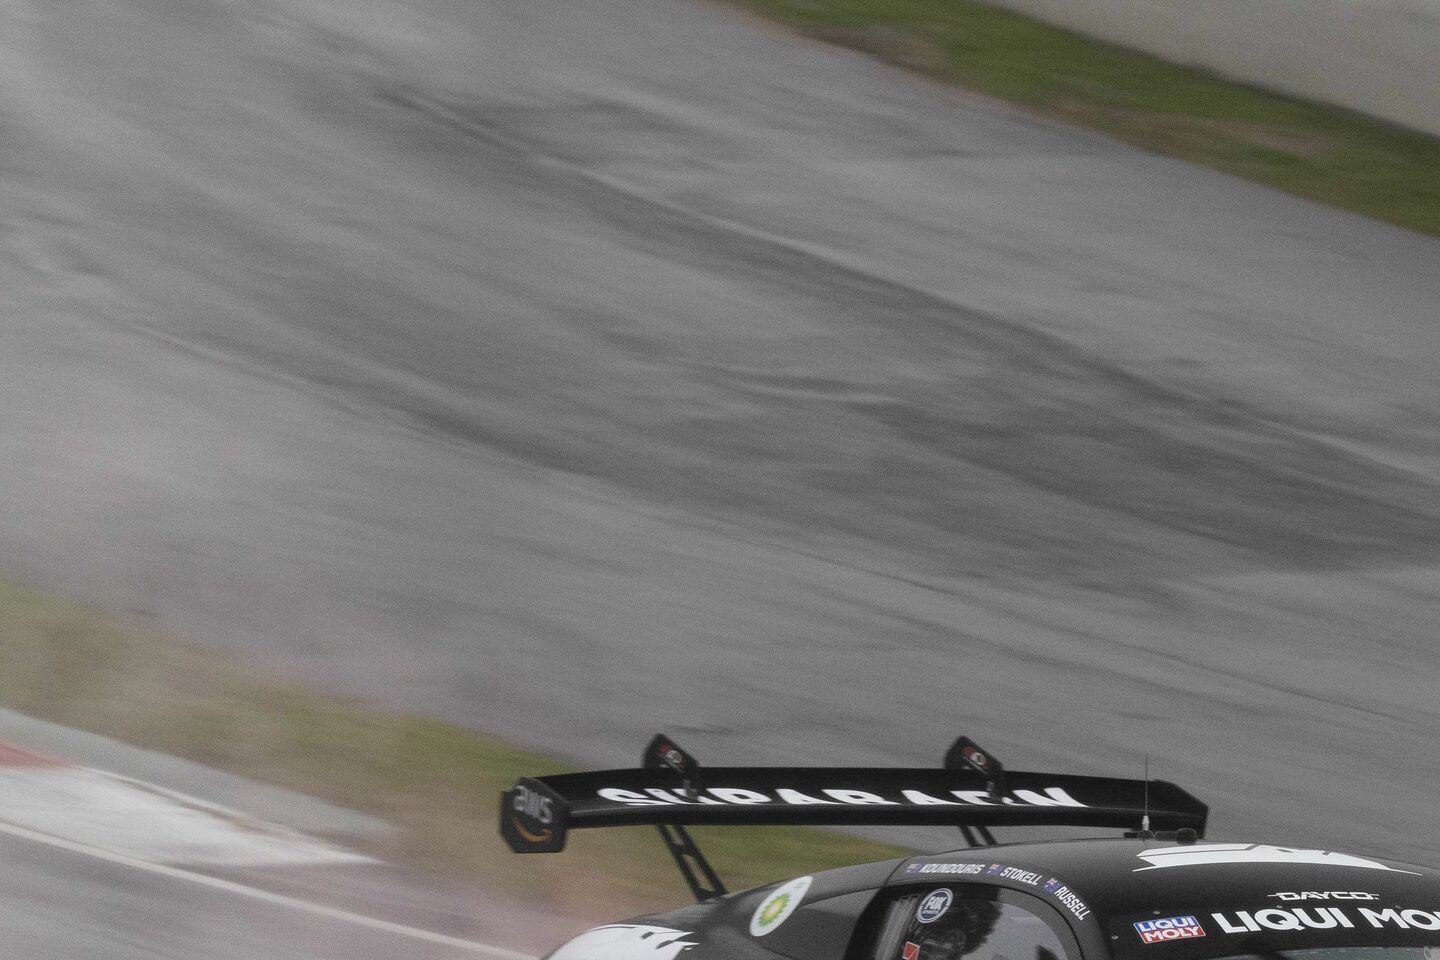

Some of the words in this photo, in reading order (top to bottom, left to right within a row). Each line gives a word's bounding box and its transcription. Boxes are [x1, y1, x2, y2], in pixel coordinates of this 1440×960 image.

[511, 785, 552, 824] aws
[1000, 866, 1043, 886] STOKELL
[923, 896, 948, 911] FOX
[1053, 886, 1092, 921] RUSSELL
[1137, 917, 1196, 932] LIQUI
[1211, 907, 1353, 934] LIQUI
[1143, 926, 1199, 942] MOLY
